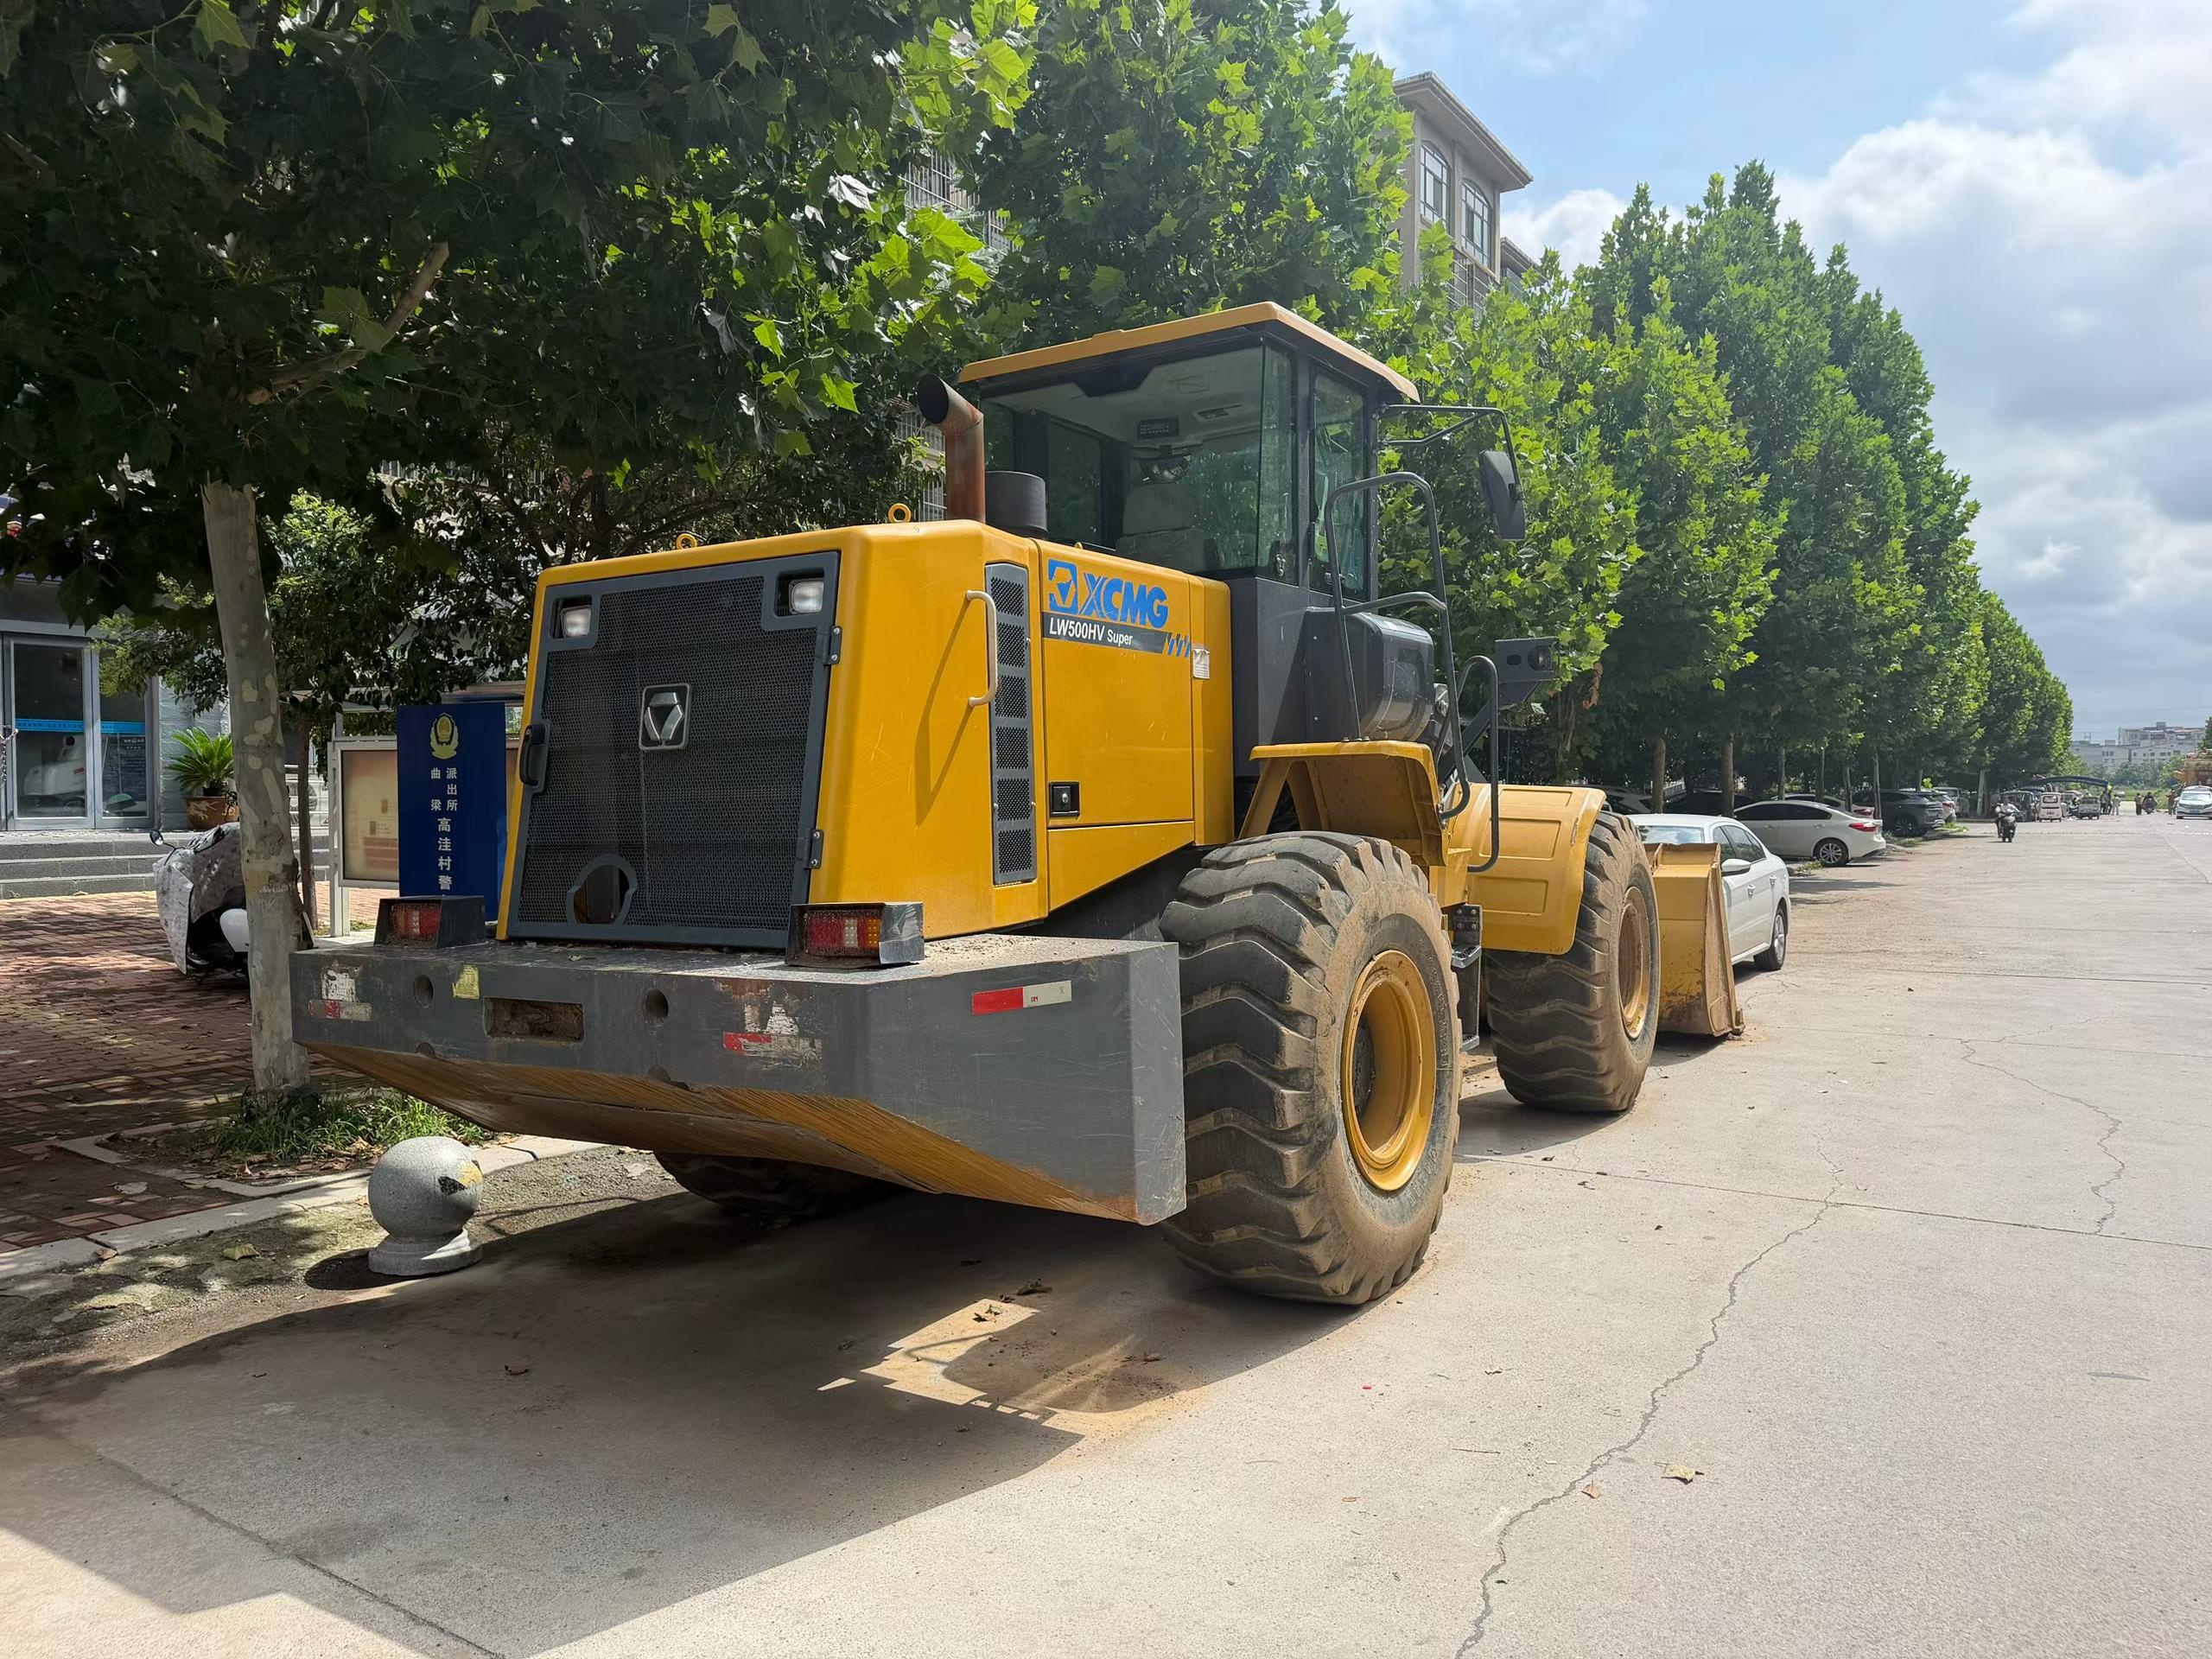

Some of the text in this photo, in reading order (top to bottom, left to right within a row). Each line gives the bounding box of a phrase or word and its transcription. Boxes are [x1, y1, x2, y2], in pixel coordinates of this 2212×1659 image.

[1081, 572, 1169, 629] XCMG
[1049, 617, 1133, 646] LW500HV Super
[430, 767, 442, 811] 曲梁
[446, 767, 458, 811] 派出所
[437, 817, 453, 896] 高洼村警
